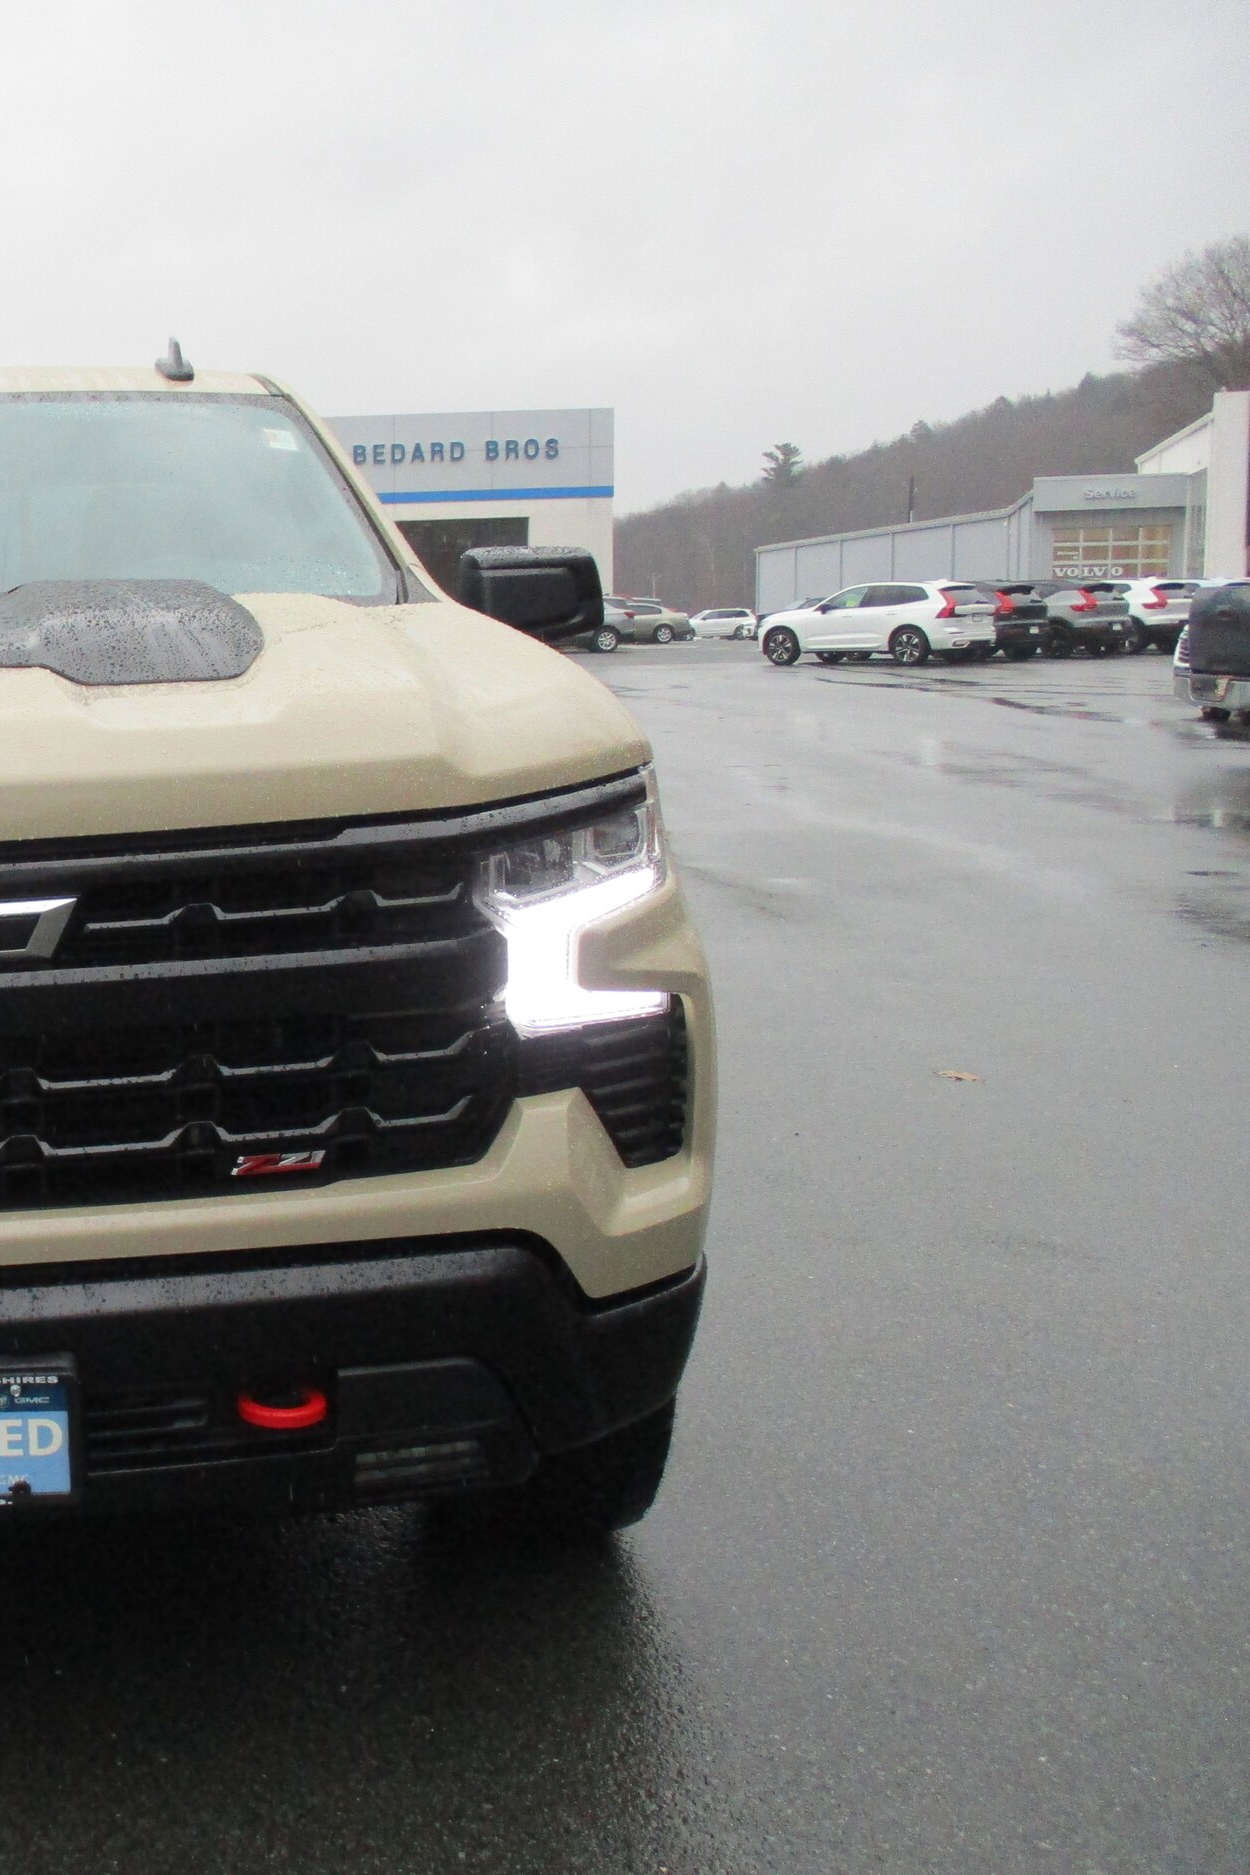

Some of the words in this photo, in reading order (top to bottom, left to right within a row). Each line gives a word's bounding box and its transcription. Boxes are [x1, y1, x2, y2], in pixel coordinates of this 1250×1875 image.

[353, 441, 465, 465] BEDARD
[485, 438, 559, 462] BROS
[1084, 487, 1136, 500] Service
[1053, 566, 1123, 577] VOLVO
[231, 1150, 326, 1176] Z71
[14, 1396, 49, 1404] GMC
